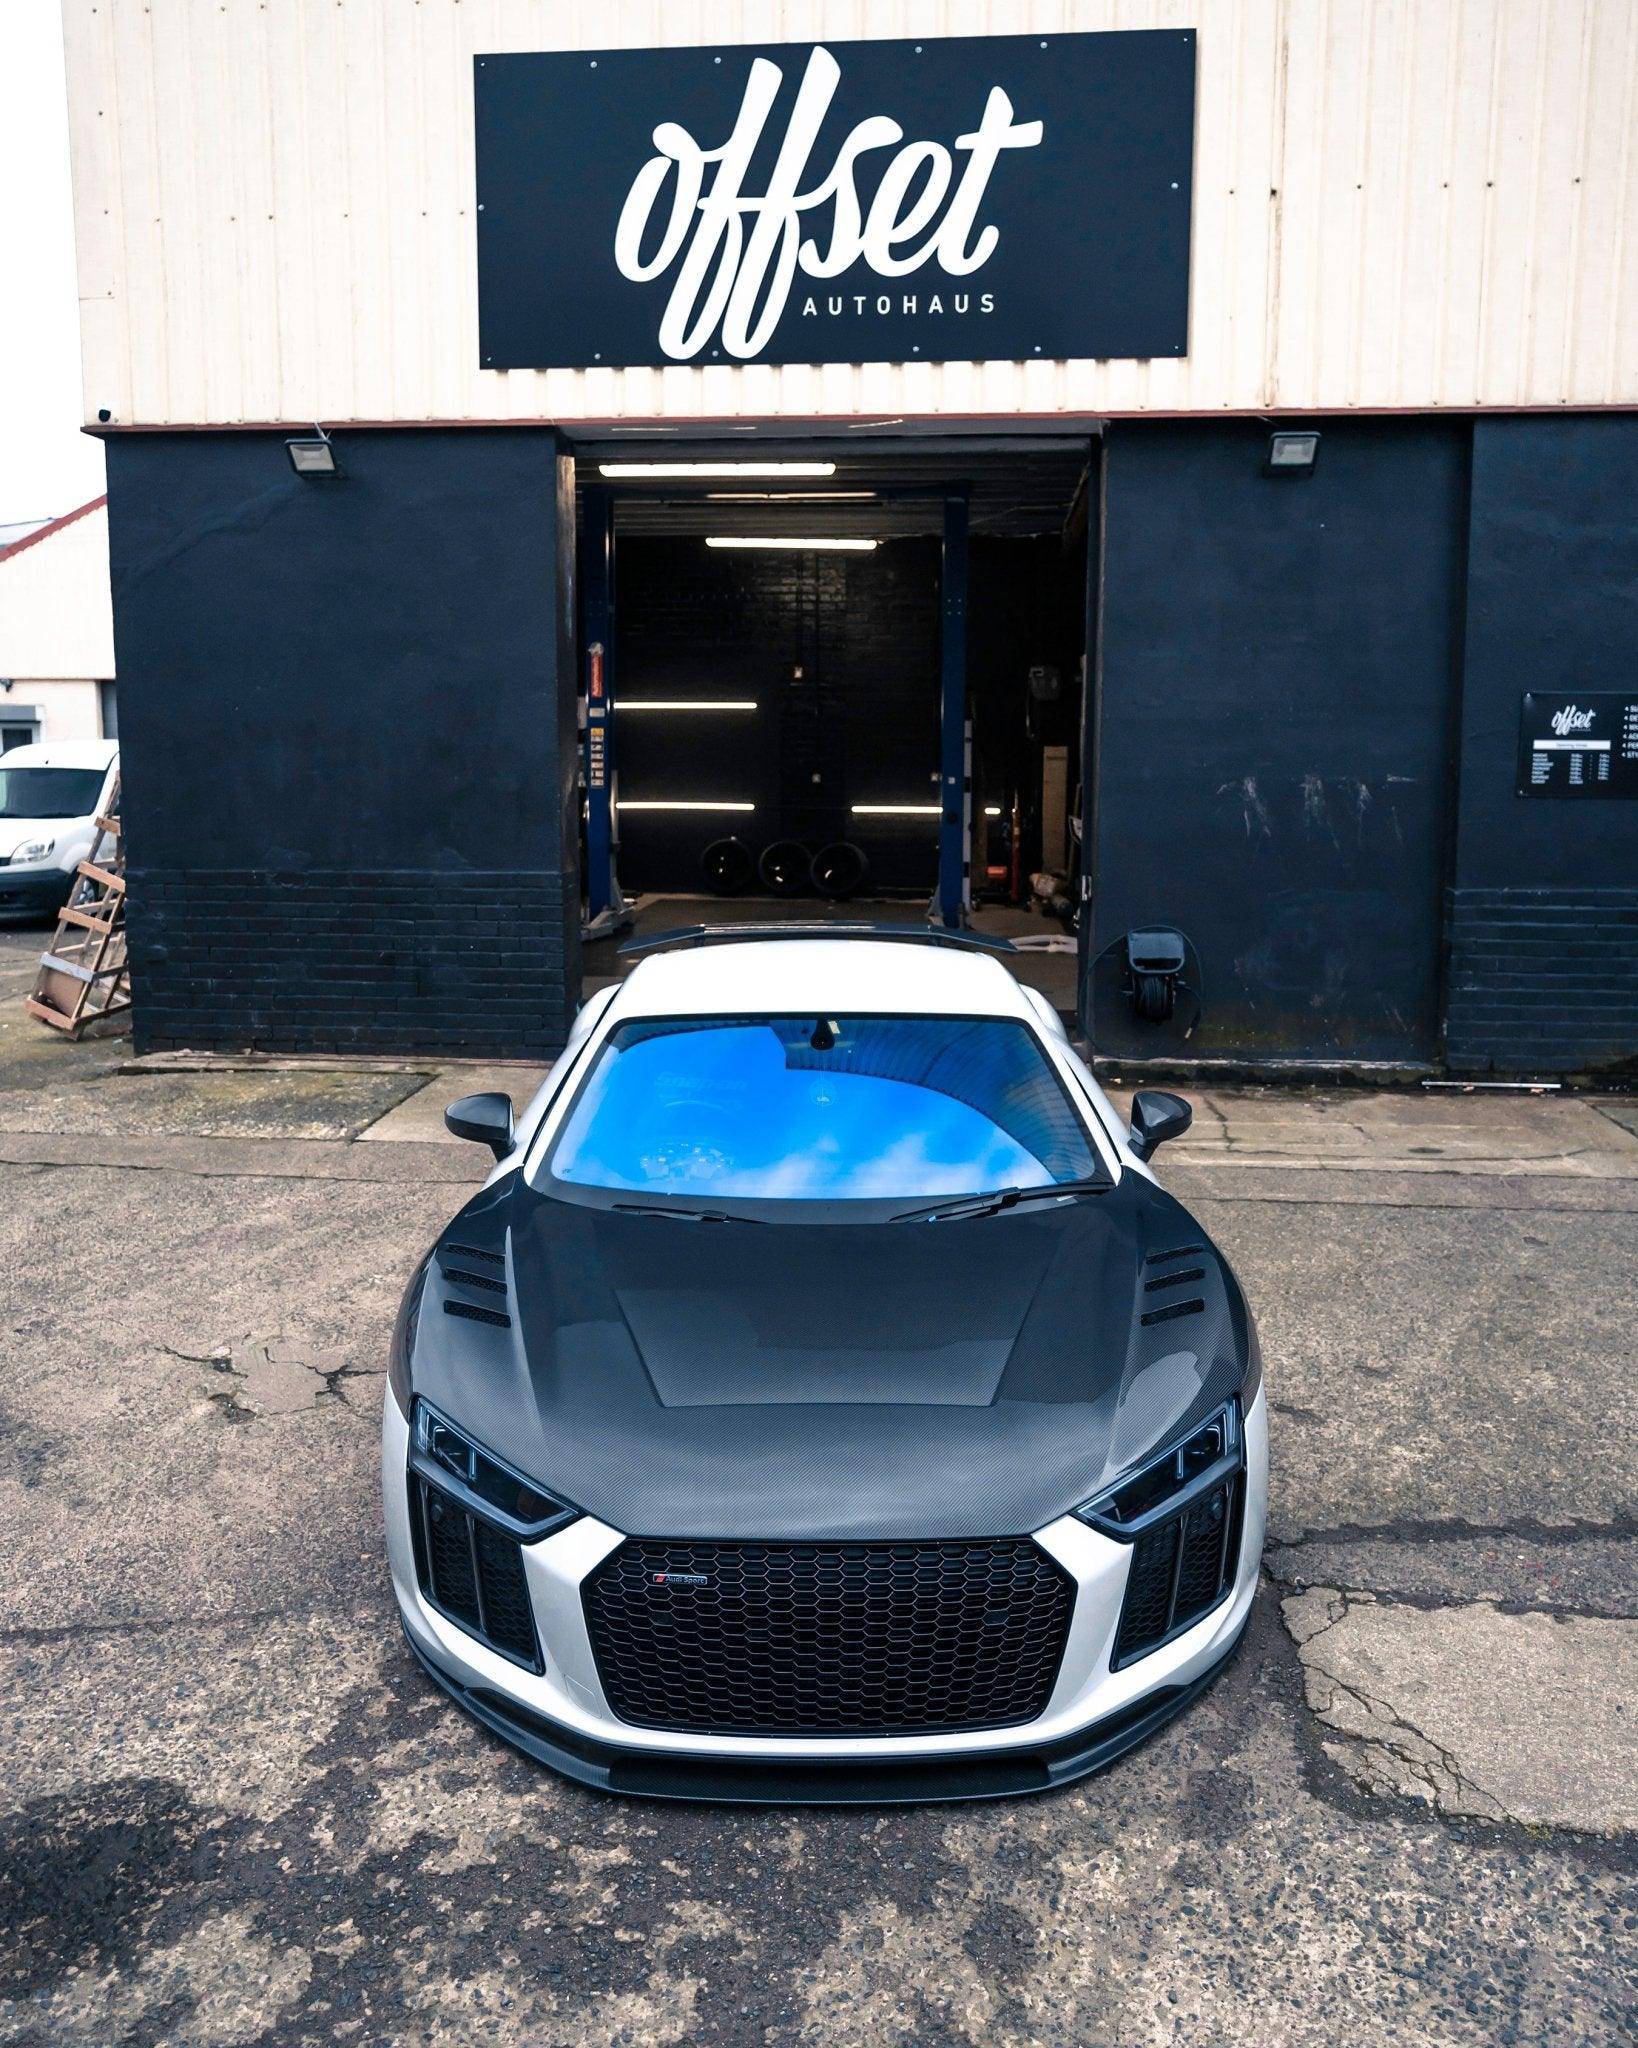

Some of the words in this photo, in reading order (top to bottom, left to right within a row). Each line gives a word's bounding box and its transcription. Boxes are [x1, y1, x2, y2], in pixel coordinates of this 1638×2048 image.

[615, 46, 1043, 359] offset
[803, 294, 994, 316] AUTOHAUS
[1551, 705, 1596, 735] offset
[683, 1576, 705, 1584] Sport
